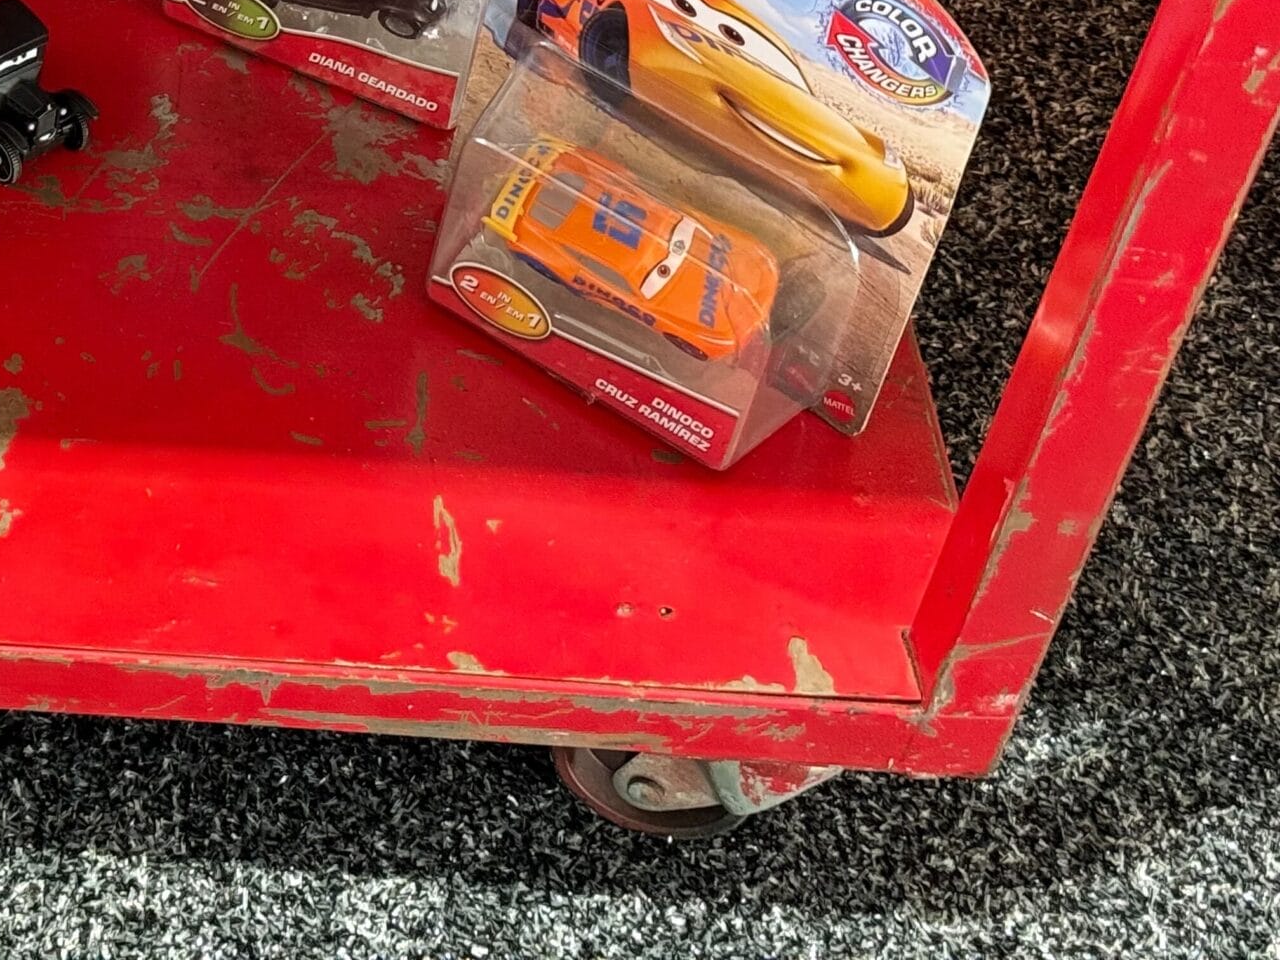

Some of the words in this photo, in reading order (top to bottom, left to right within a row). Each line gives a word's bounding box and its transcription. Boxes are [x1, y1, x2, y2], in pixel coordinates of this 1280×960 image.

[227, 0, 240, 11] IN
[256, 16, 270, 30] 1
[855, 0, 937, 63] COLOR
[308, 51, 356, 78] DIANA
[358, 71, 439, 112] GEARDADO
[835, 33, 938, 98] CHANGERS
[460, 275, 479, 292] 2
[497, 291, 512, 304] IN
[527, 312, 542, 330] 1
[823, 396, 856, 417] MATTEL
[837, 373, 862, 392] 3+
[595, 378, 639, 409] CRUZ
[638, 404, 711, 452] RAMÍREZ
[651, 397, 714, 439] DINOCO
